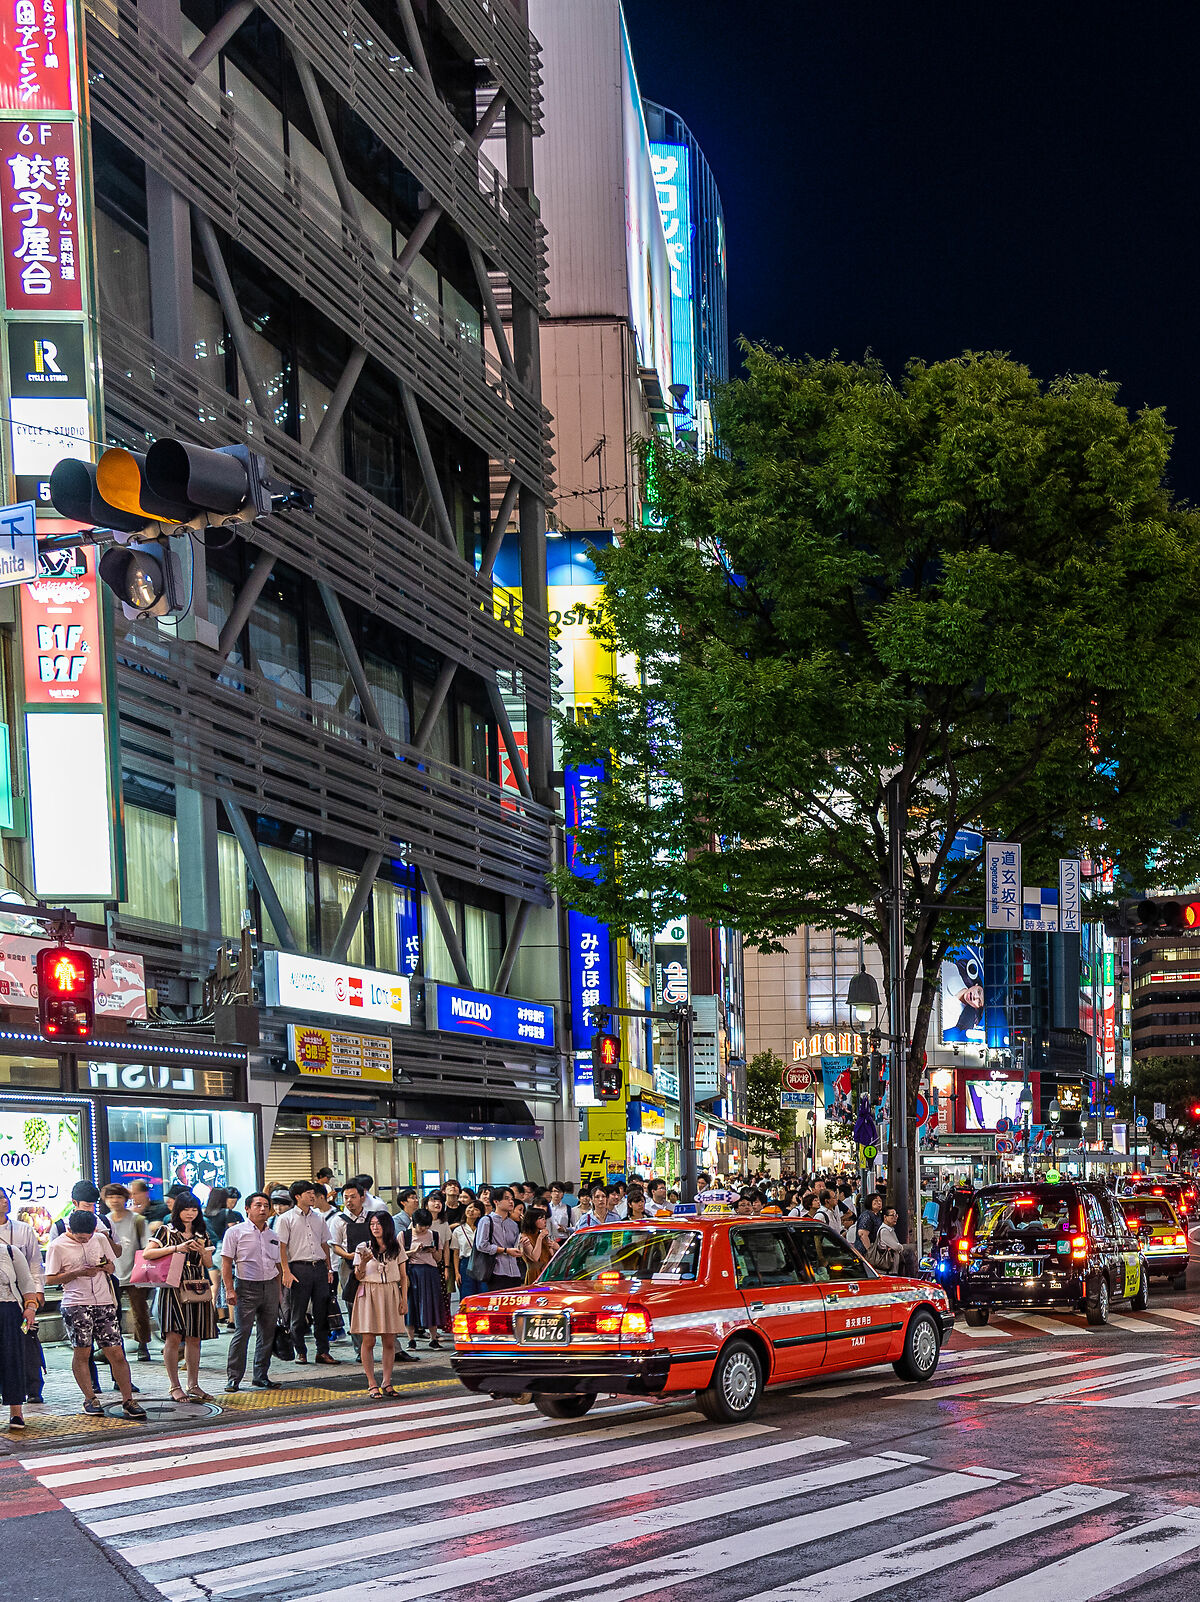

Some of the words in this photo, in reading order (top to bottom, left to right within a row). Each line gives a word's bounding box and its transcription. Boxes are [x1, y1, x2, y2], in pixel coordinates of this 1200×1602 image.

[7, 153, 57, 295] 餃子屋台
[37, 625, 84, 651] B1F
[38, 655, 88, 682] B2F
[991, 857, 1000, 895] Dogenzaka
[1001, 850, 1017, 922] 道玄坂下
[673, 929, 682, 938] 1F
[1025, 920, 1057, 932] 時差式
[581, 933, 600, 1027] みずほ銀行
[664, 962, 688, 1004] HUB
[451, 996, 492, 1021] MIZUHO
[789, 1073, 810, 1085] 消火栓
[112, 1159, 153, 1173] MIZUHO
[706, 1203, 722, 1213] 1259
[532, 1326, 564, 1341] 40-76
[851, 1337, 866, 1347] TAXI
